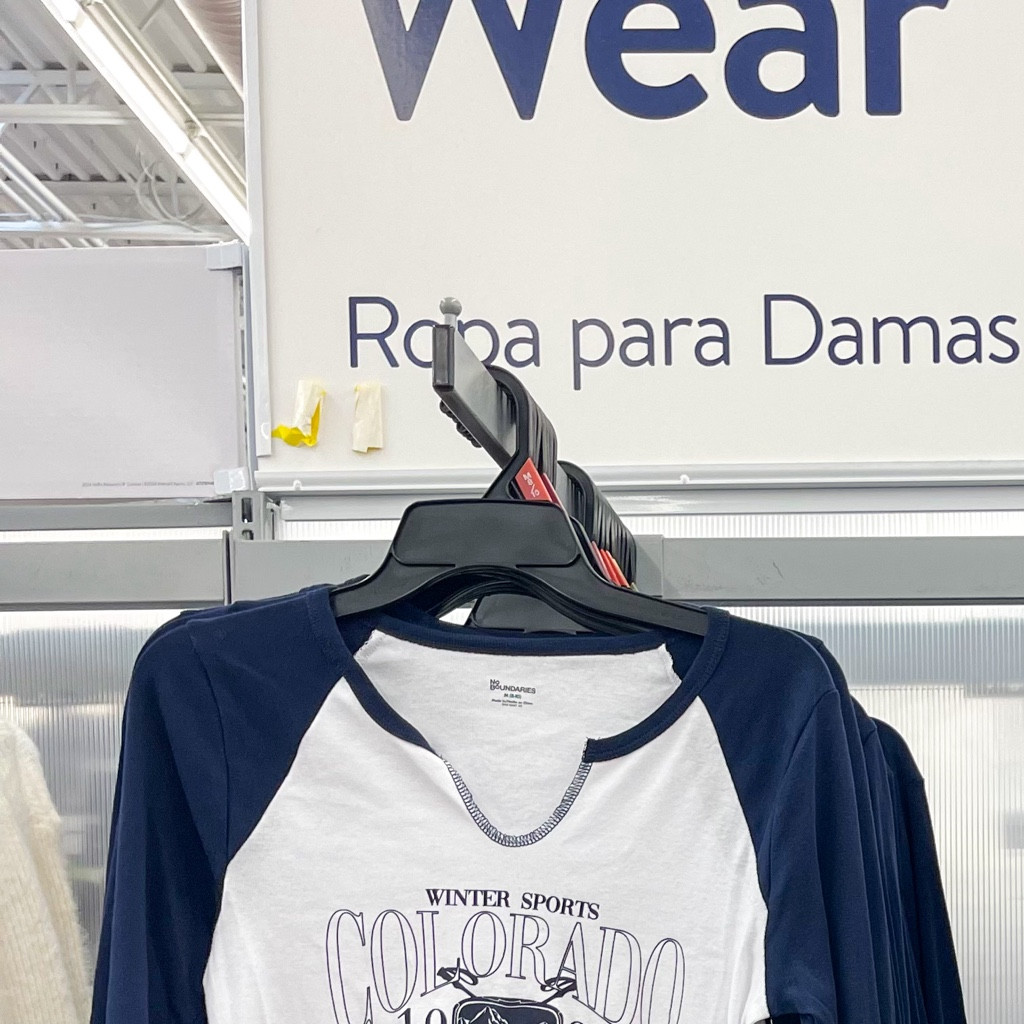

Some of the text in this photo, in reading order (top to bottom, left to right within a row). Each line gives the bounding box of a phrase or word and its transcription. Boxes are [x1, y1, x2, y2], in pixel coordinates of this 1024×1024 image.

[362, 0, 949, 120] Wear
[572, 317, 731, 391] para
[763, 294, 1020, 366] Damas
[425, 888, 601, 921] WINTER SPORTS
